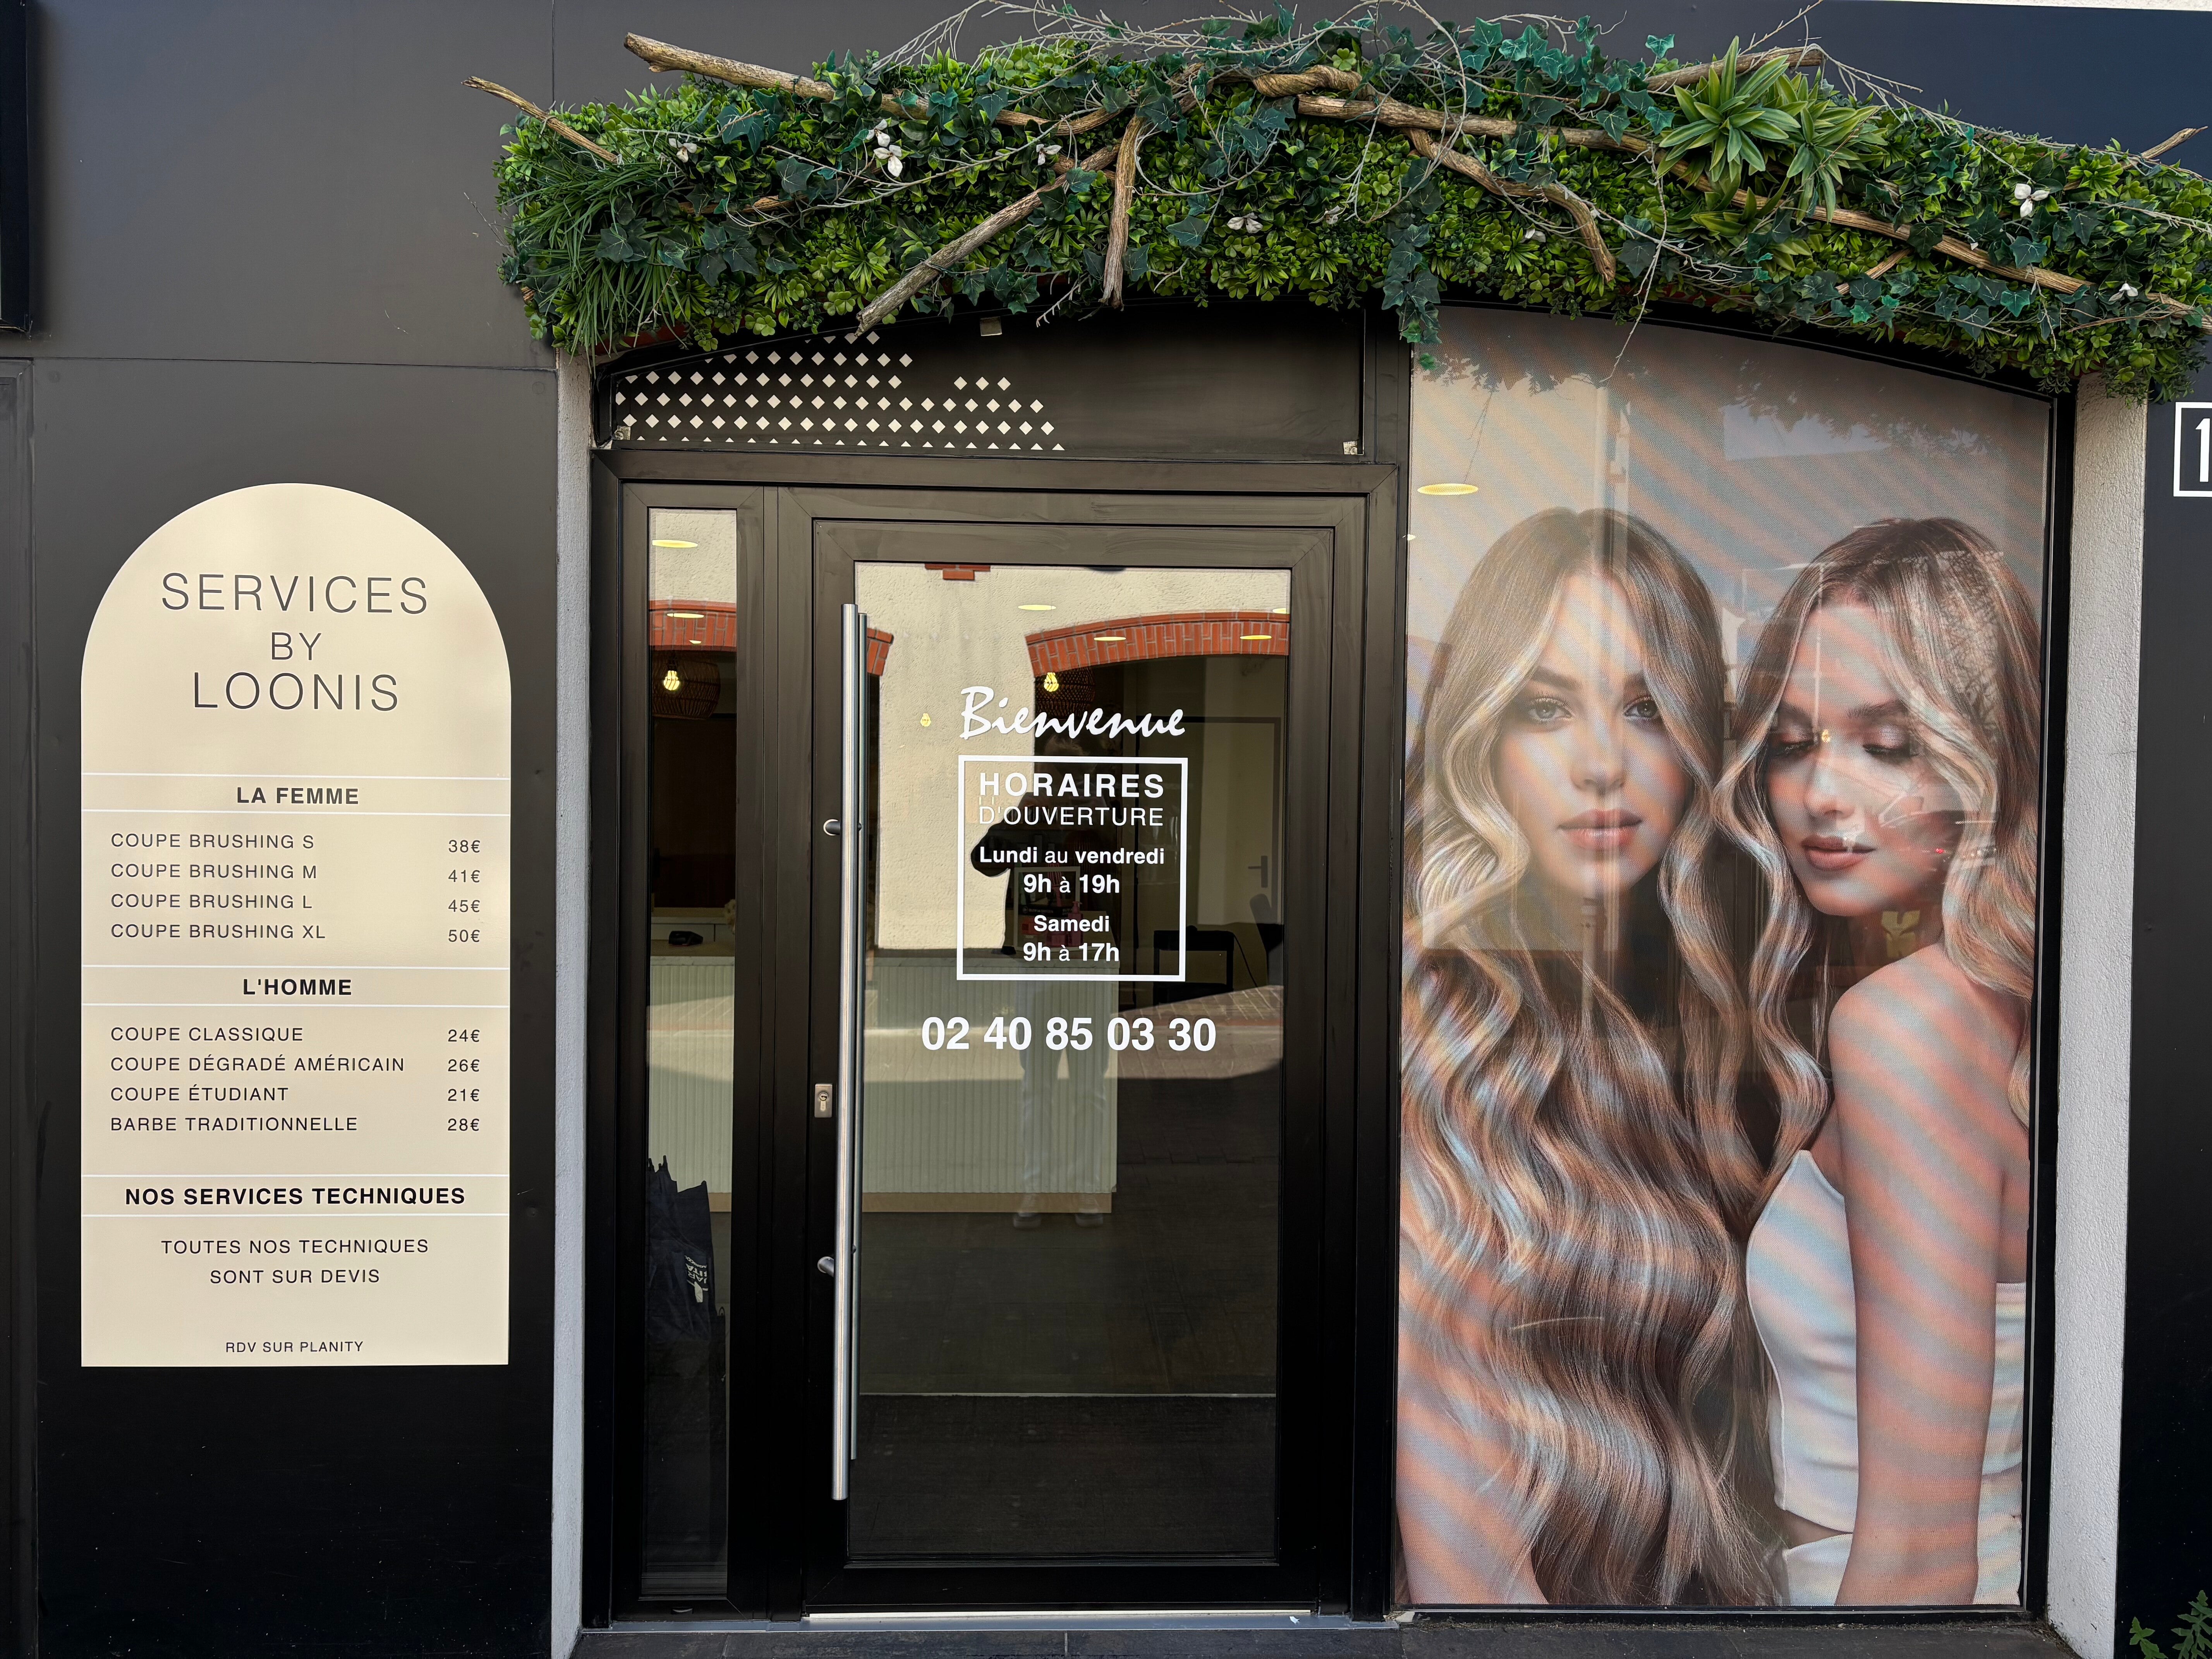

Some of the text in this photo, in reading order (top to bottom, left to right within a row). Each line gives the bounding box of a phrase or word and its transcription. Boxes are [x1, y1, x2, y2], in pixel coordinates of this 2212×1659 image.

[162, 573, 427, 615] SERVICES
[272, 632, 322, 661] BY
[194, 672, 398, 712] LOONIS
[960, 686, 1185, 740] Bienvenue
[979, 773, 1164, 798] HORAIRES
[237, 787, 359, 805] LA FEMME
[979, 806, 1163, 826] D'OUVERTURE
[112, 833, 481, 854] COUPE BRUSHING S 38€
[981, 847, 1164, 864] Lundi au vendredi
[111, 864, 481, 883] COUPE BRUSHING M 41€
[1024, 874, 1120, 894] 9h à 19h
[111, 894, 481, 913] COUPE BRUSHING L 45€
[1034, 915, 1109, 932] Samedi
[111, 924, 481, 943] COUPE BRUSHING XL 50€
[1024, 943, 1119, 962] 9h à 17h
[244, 979, 352, 996] L'HOMME
[111, 1027, 481, 1043] COUPE CLASSIQUE 24€
[922, 1017, 1216, 1052] 02 40 85 03 30
[111, 1054, 480, 1073] COUPE DÉGRADÉ AMÉRICAIN 26€
[111, 1084, 480, 1102] COUPE ÉTUDIANT 21€
[112, 1117, 480, 1132] BARBE TRADITIONNELLE 28€
[126, 1188, 465, 1206] NOS SERVICES TECHNIQUES
[161, 1239, 428, 1255] TOUTES NOS TECHNIQUES
[210, 1269, 380, 1284] SONT SUR DEVIS
[226, 1341, 364, 1353] RDV SUR PLANITY
